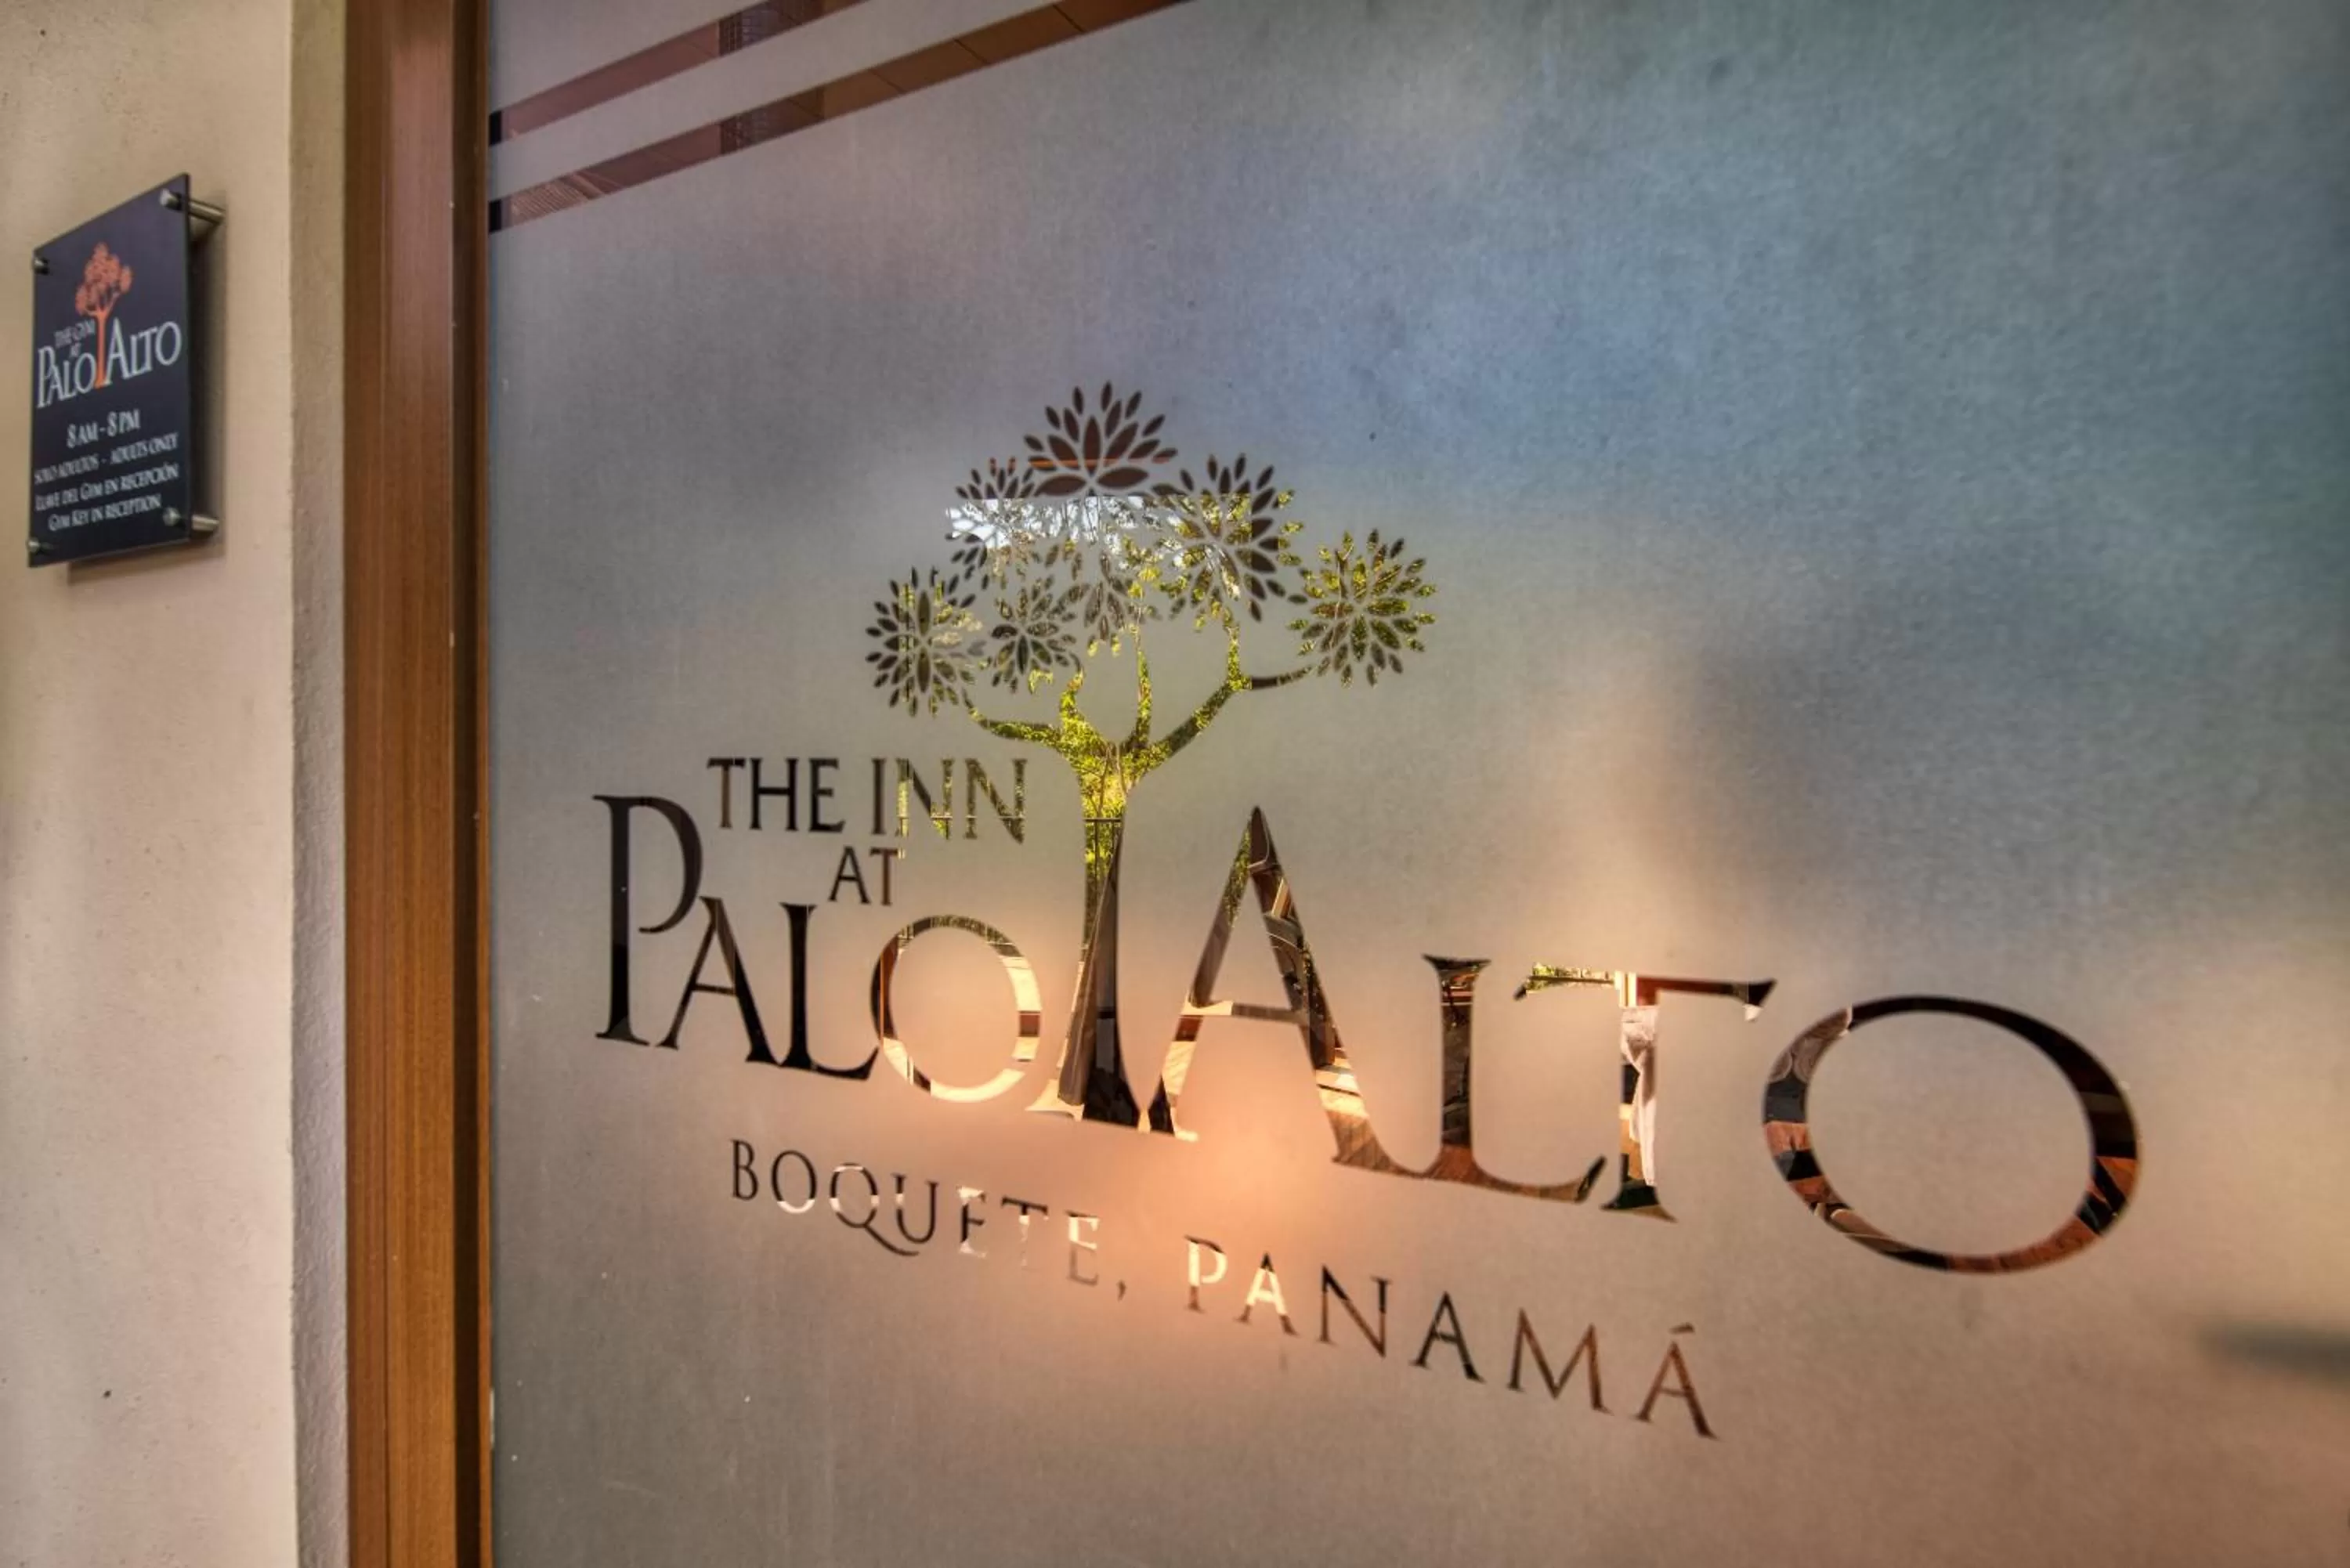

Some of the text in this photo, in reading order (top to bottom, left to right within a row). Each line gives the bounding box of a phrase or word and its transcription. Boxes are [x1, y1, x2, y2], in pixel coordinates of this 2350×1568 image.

[37, 316, 183, 409] PALO ALTO
[110, 439, 148, 464] ADULTS
[148, 432, 179, 454] ONLY
[104, 478, 118, 495] EN
[105, 493, 161, 519] RECEPTION
[706, 757, 1029, 844] THE INN
[827, 845, 906, 907] AT
[592, 794, 2140, 1274] PALO ALTO
[730, 1139, 1719, 1440] BOQUETE, PANAMÁ
